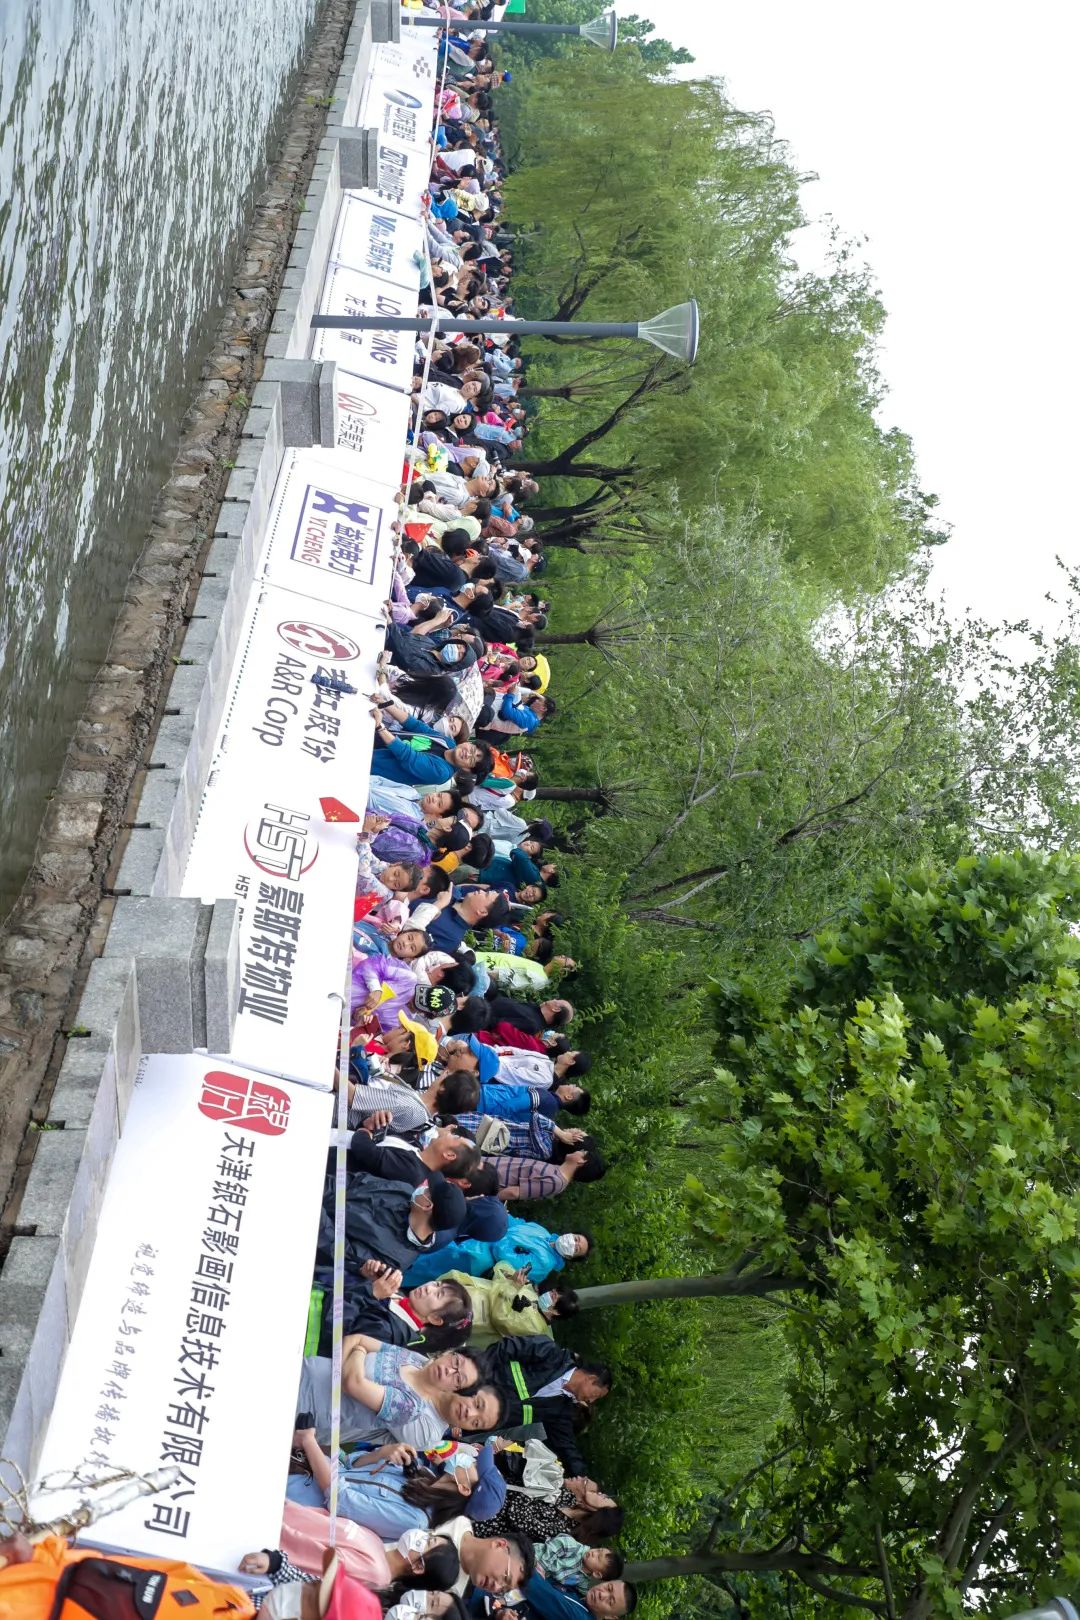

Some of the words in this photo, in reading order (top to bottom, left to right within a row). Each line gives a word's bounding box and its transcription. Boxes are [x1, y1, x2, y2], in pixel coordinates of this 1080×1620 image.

[370, 295, 402, 364] LOKING
[309, 516, 328, 528] YI
[302, 528, 325, 564] CHENG
[328, 523, 366, 575] 益诚电力
[271, 652, 306, 696] A&R
[252, 697, 298, 746] Corp
[234, 874, 250, 900] HST
[238, 882, 304, 1025] 豪斯特物业
